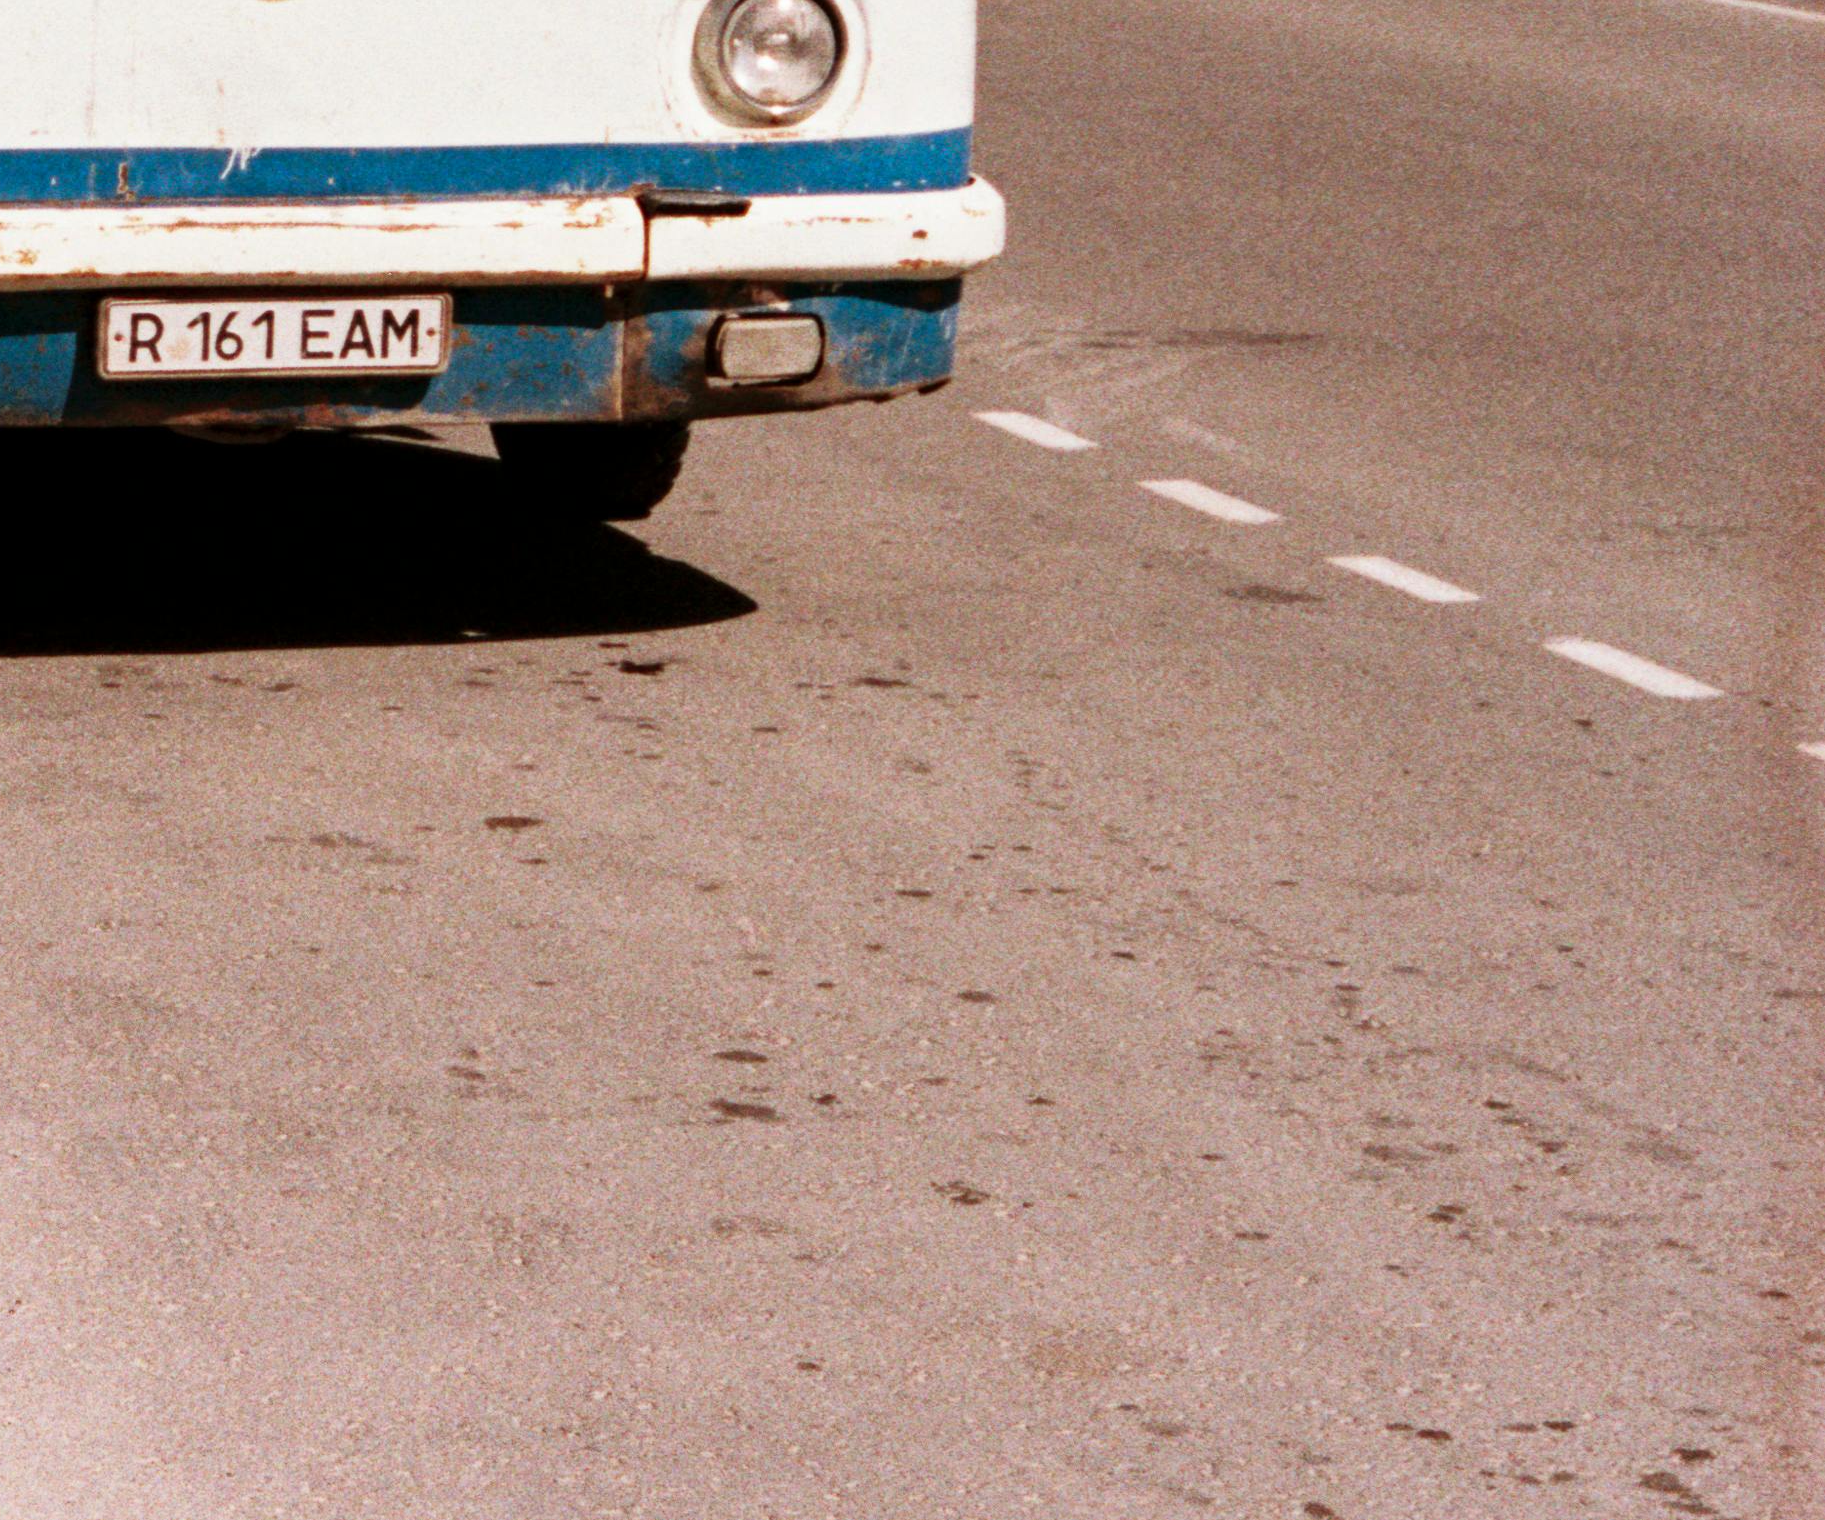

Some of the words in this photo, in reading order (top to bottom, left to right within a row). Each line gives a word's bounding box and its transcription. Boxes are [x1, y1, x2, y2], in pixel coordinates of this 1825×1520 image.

[128, 312, 164, 363] R
[187, 310, 275, 361] 161
[300, 308, 420, 360] EAM
